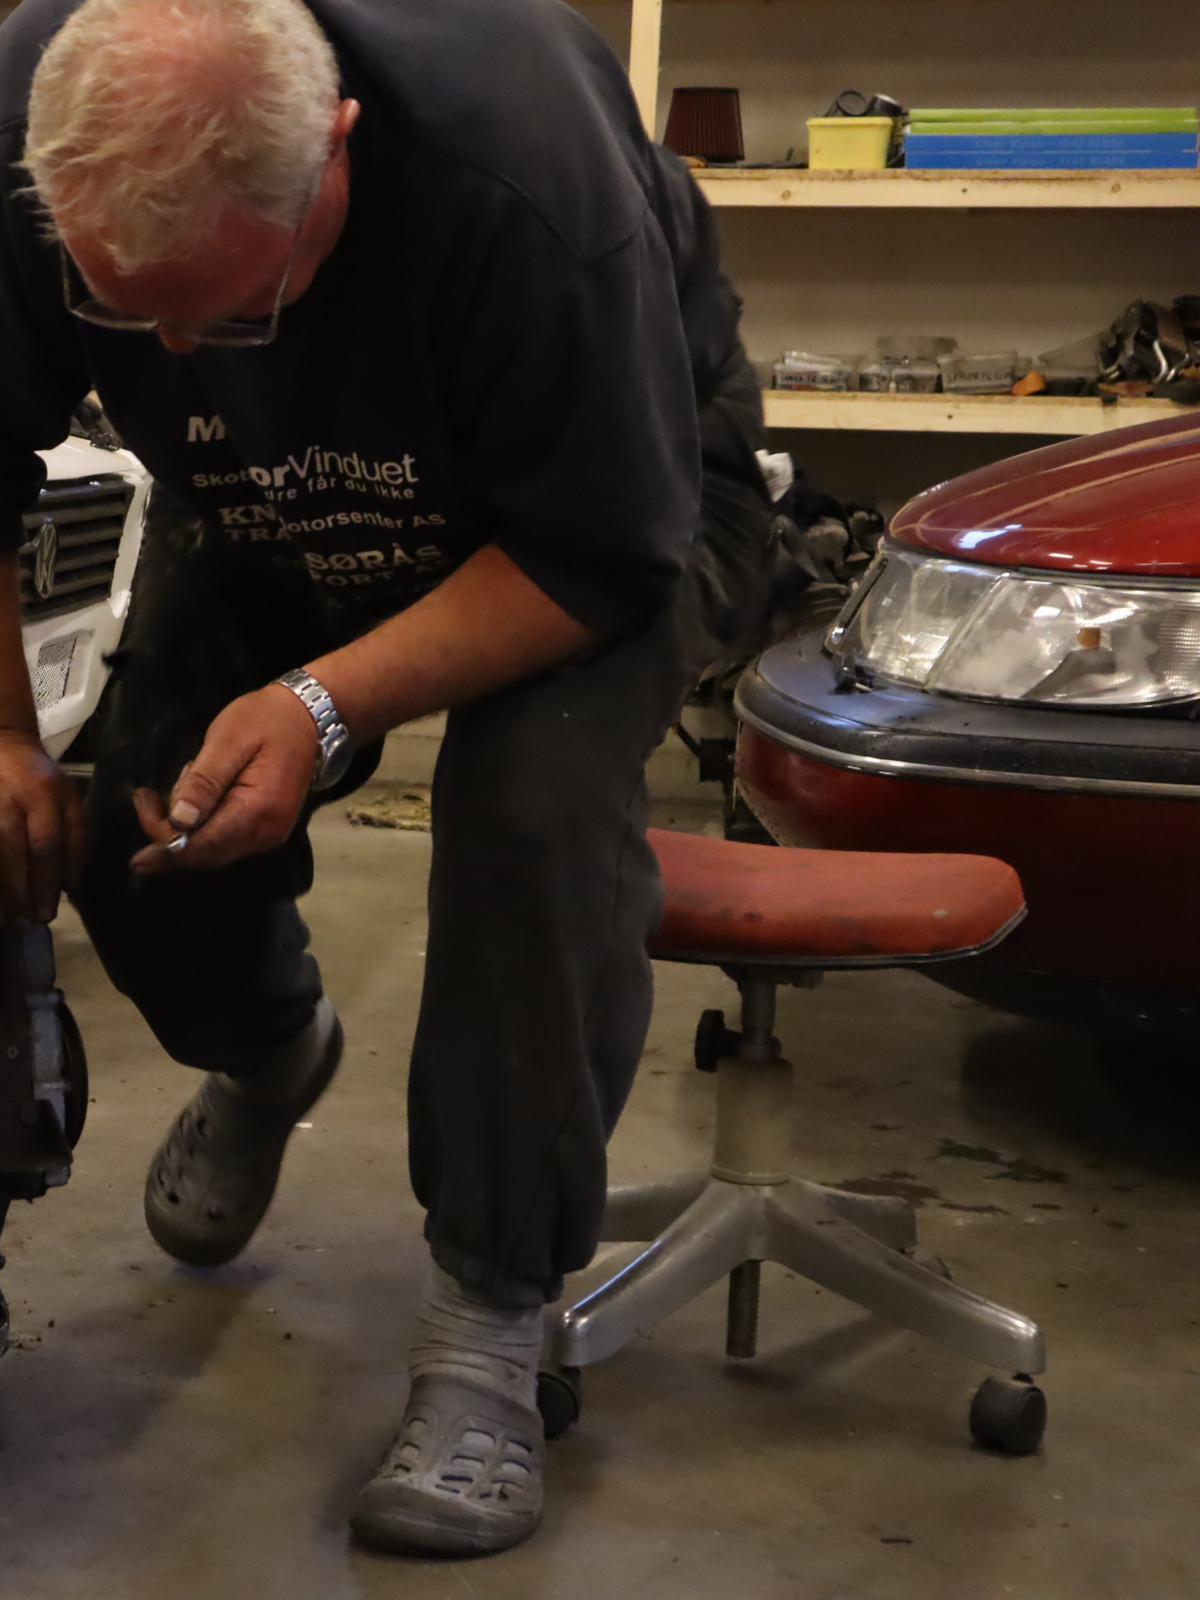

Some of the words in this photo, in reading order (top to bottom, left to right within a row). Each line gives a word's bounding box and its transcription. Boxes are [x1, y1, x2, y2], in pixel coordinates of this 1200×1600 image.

[345, 479, 367, 493] du
[373, 482, 414, 500] ikke
[278, 511, 403, 533] otorsenter
[412, 513, 447, 528] AS
